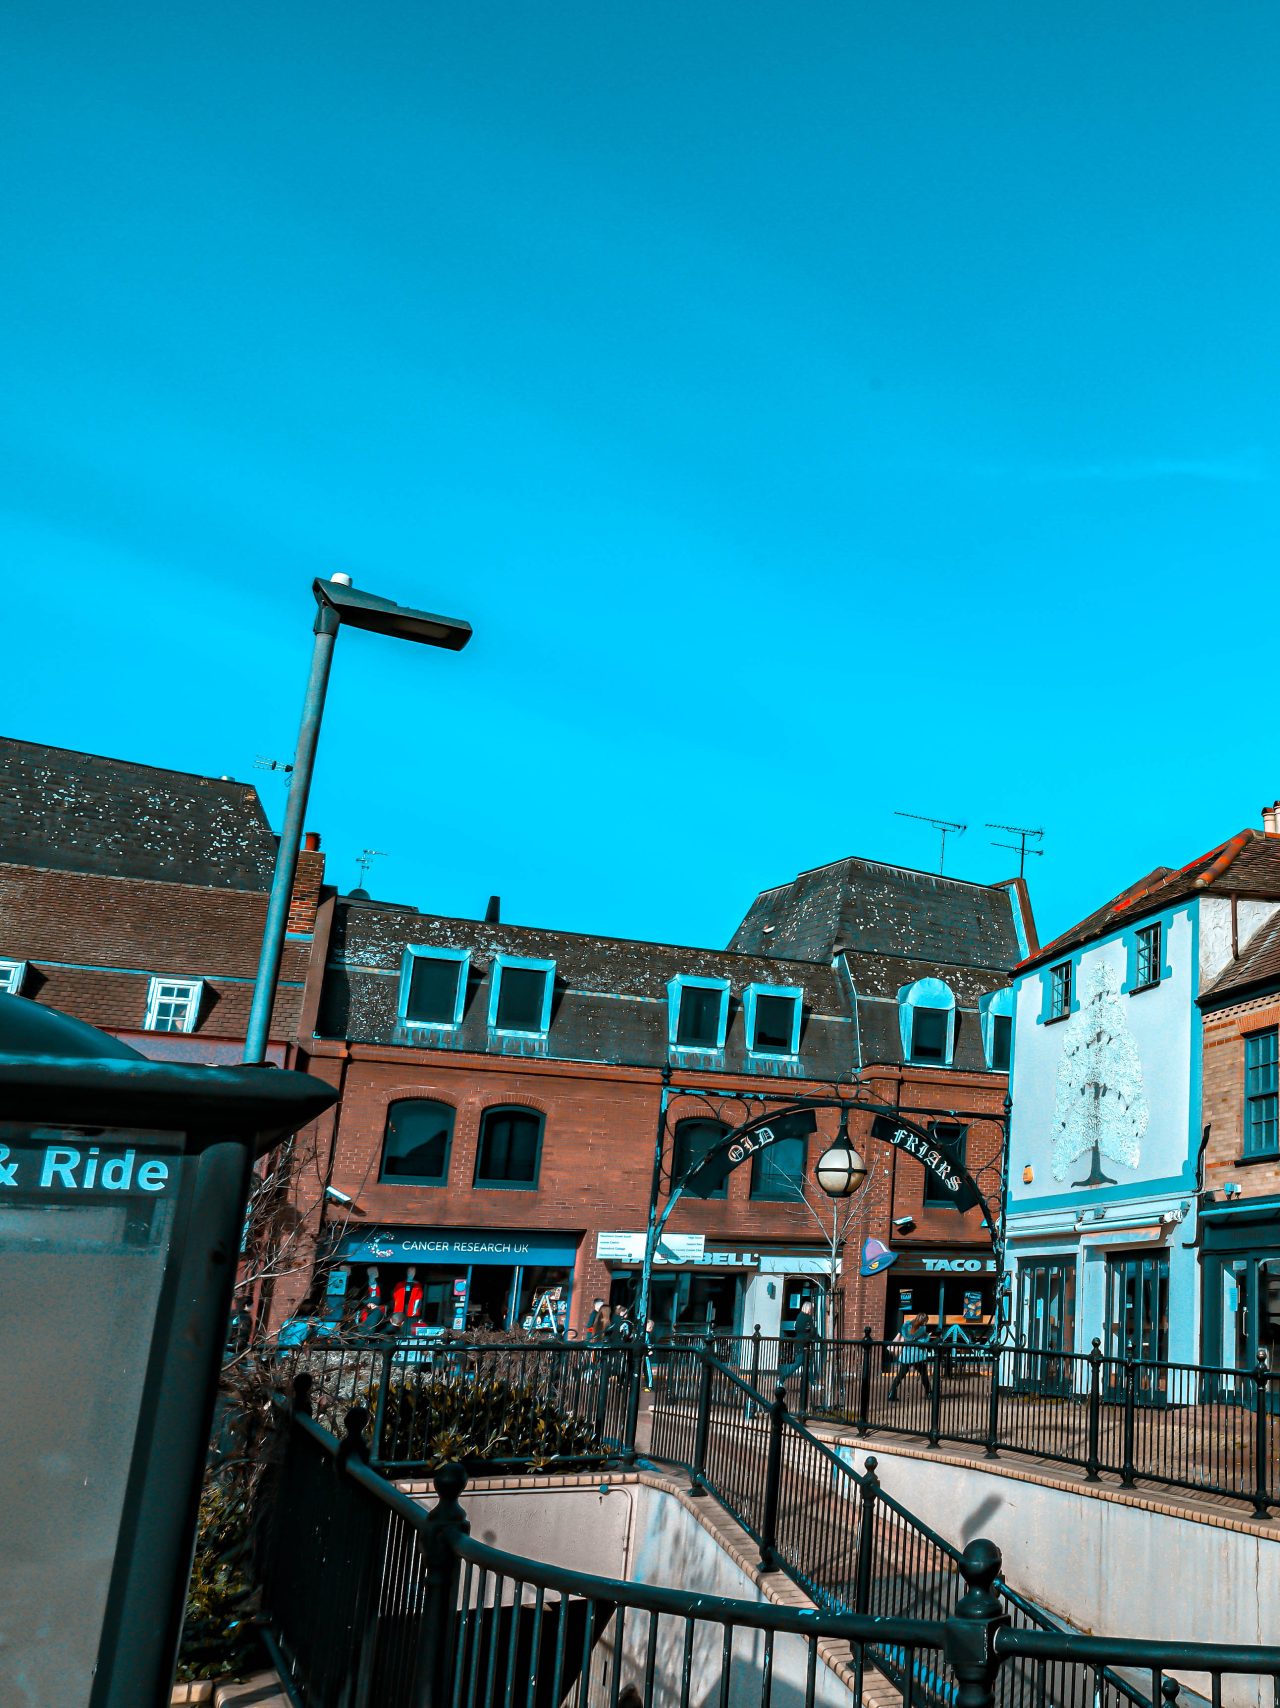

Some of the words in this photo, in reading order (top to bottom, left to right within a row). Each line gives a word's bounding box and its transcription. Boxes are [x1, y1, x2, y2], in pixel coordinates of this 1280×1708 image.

[40, 1146, 169, 1191] Ride
[728, 1127, 774, 1163] OLD
[889, 1129, 963, 1192] FRIARS
[402, 1240, 449, 1251] CANCER
[453, 1242, 511, 1253] RESEARCH
[513, 1244, 529, 1253] UK
[922, 1258, 982, 1272] TACO
